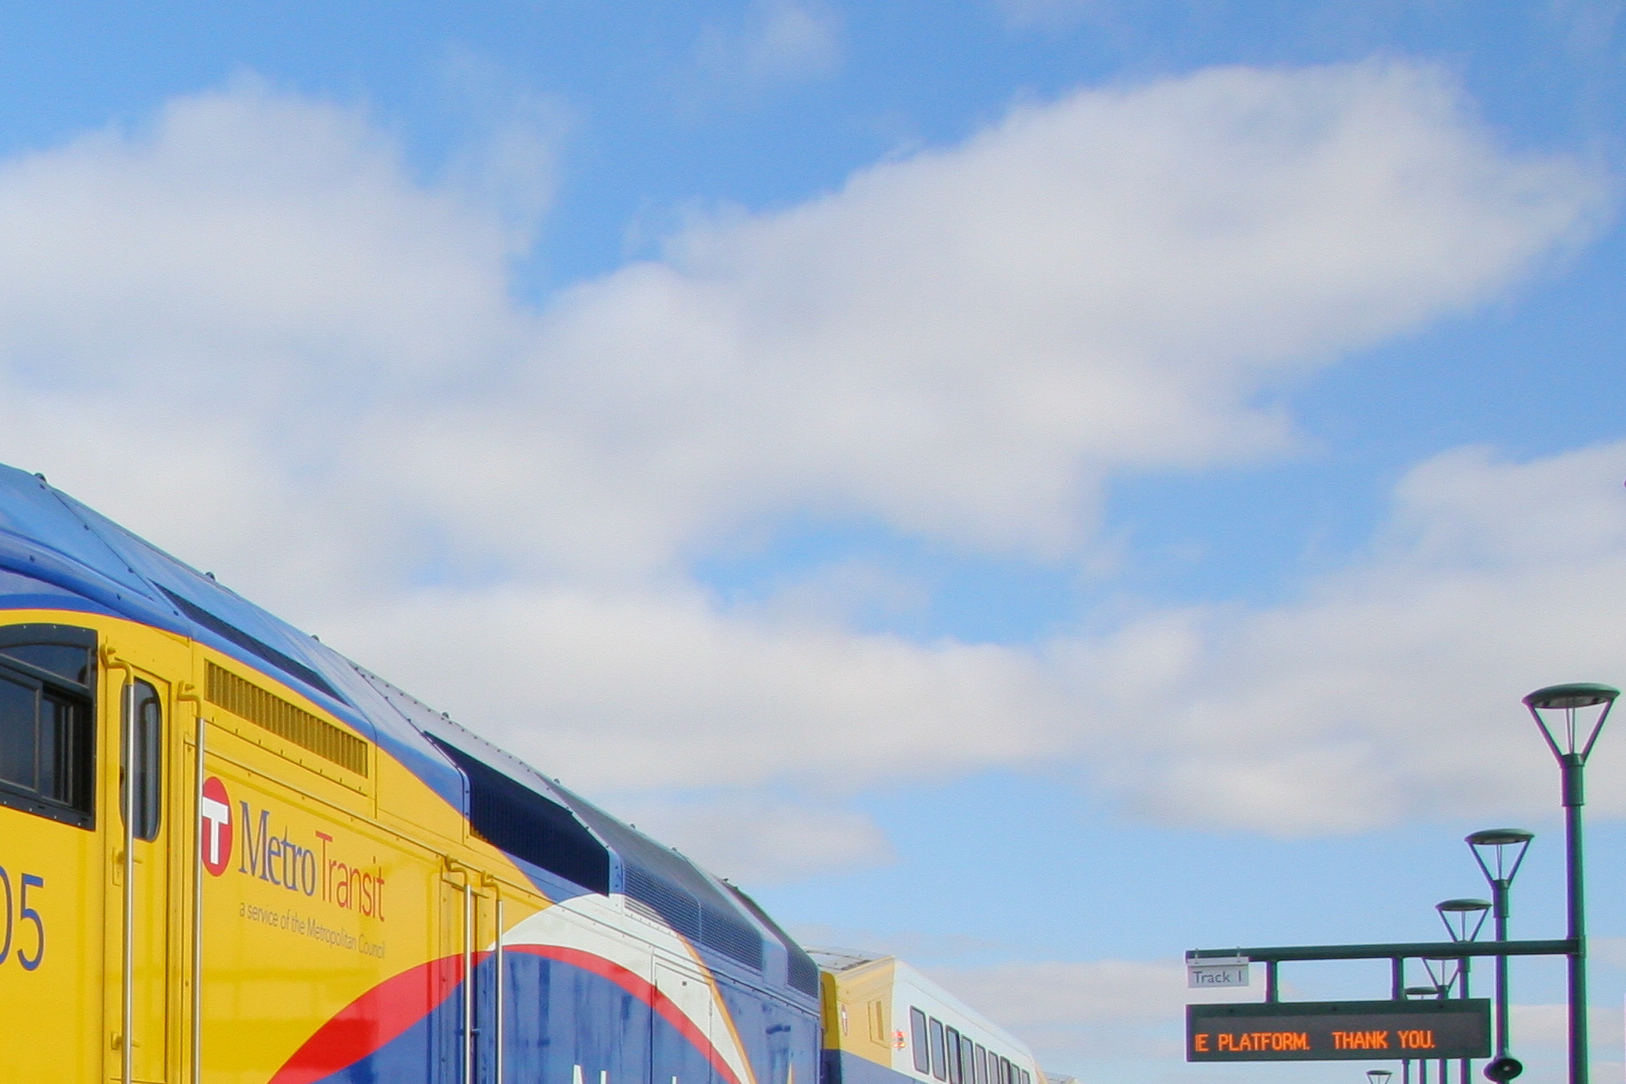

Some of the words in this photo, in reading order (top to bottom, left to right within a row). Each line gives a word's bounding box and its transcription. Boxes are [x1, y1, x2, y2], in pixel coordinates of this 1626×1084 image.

[202, 796, 228, 865] T
[247, 904, 279, 927] service
[280, 908, 291, 930] of
[291, 911, 305, 935] the
[307, 917, 356, 950] Metropolitan
[358, 933, 386, 959] Council
[1193, 970, 1231, 984] Track
[1218, 1032, 1311, 1052] PLATFORM.
[1332, 1030, 1390, 1050] THANK
[1397, 1030, 1436, 1050] YOU.
